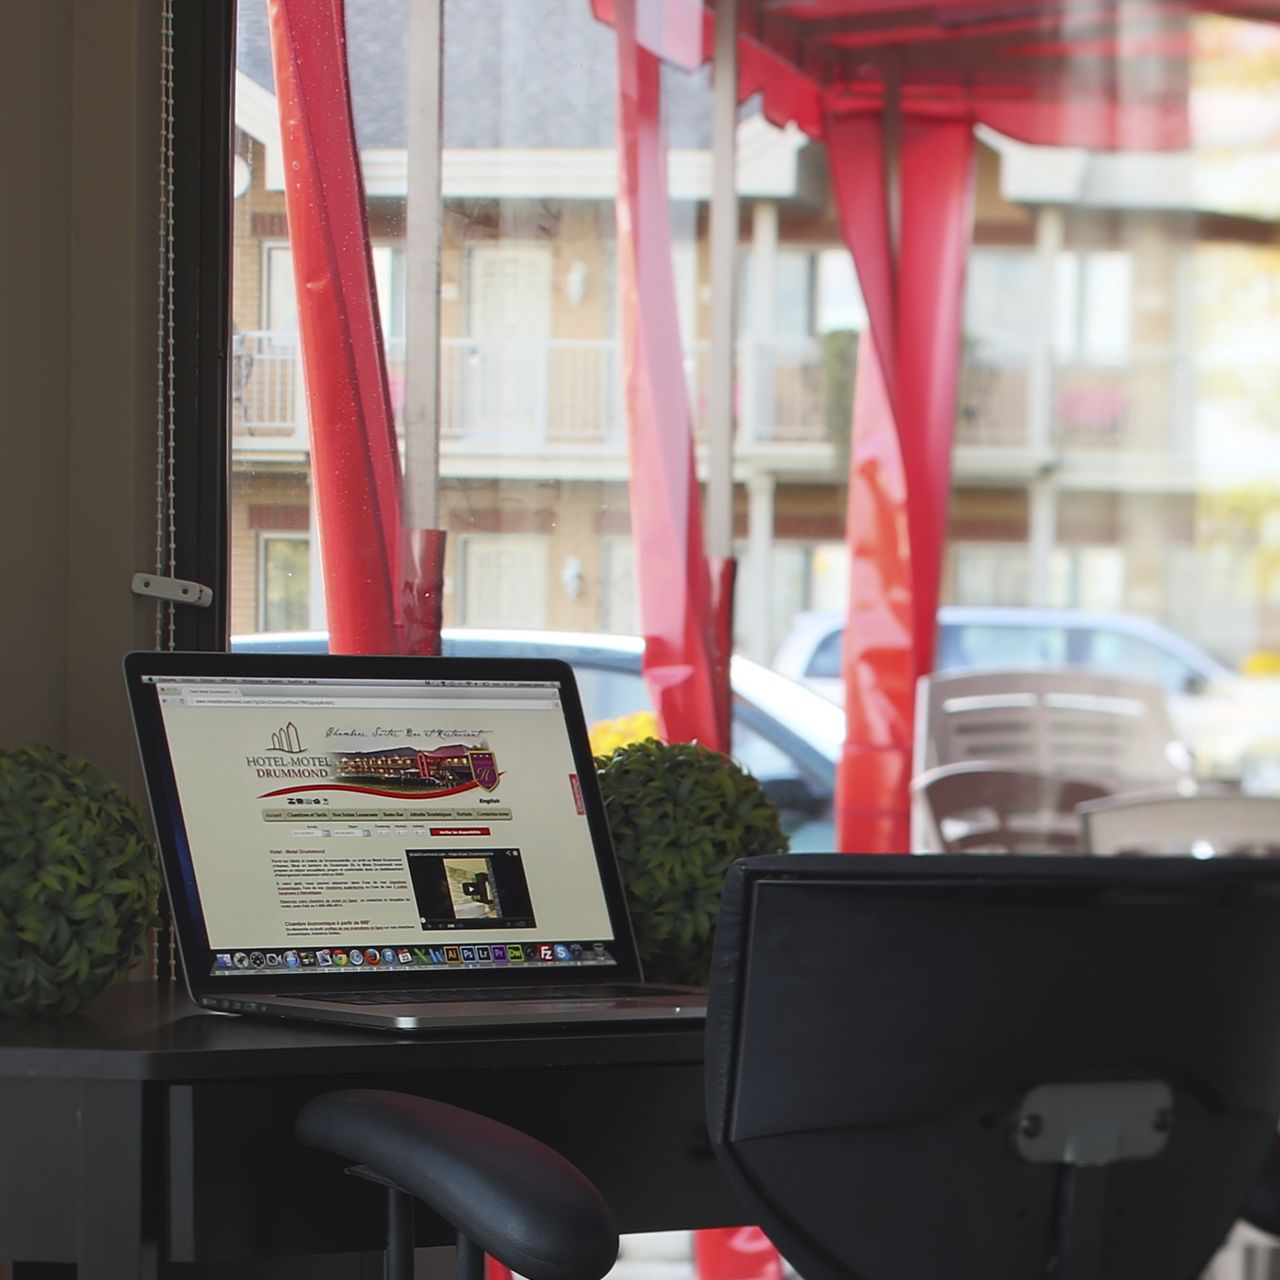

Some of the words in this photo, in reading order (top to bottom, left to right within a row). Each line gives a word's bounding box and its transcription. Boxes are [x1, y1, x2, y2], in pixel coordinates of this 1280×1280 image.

[246, 756, 332, 768] HOTEL-MOTEL
[256, 768, 328, 778] DRUMMOND
[448, 950, 457, 959] Ai
[463, 950, 473, 959] Ps
[479, 949, 488, 958] Lr
[495, 949, 503, 958] Pr
[540, 946, 553, 959] Fz
